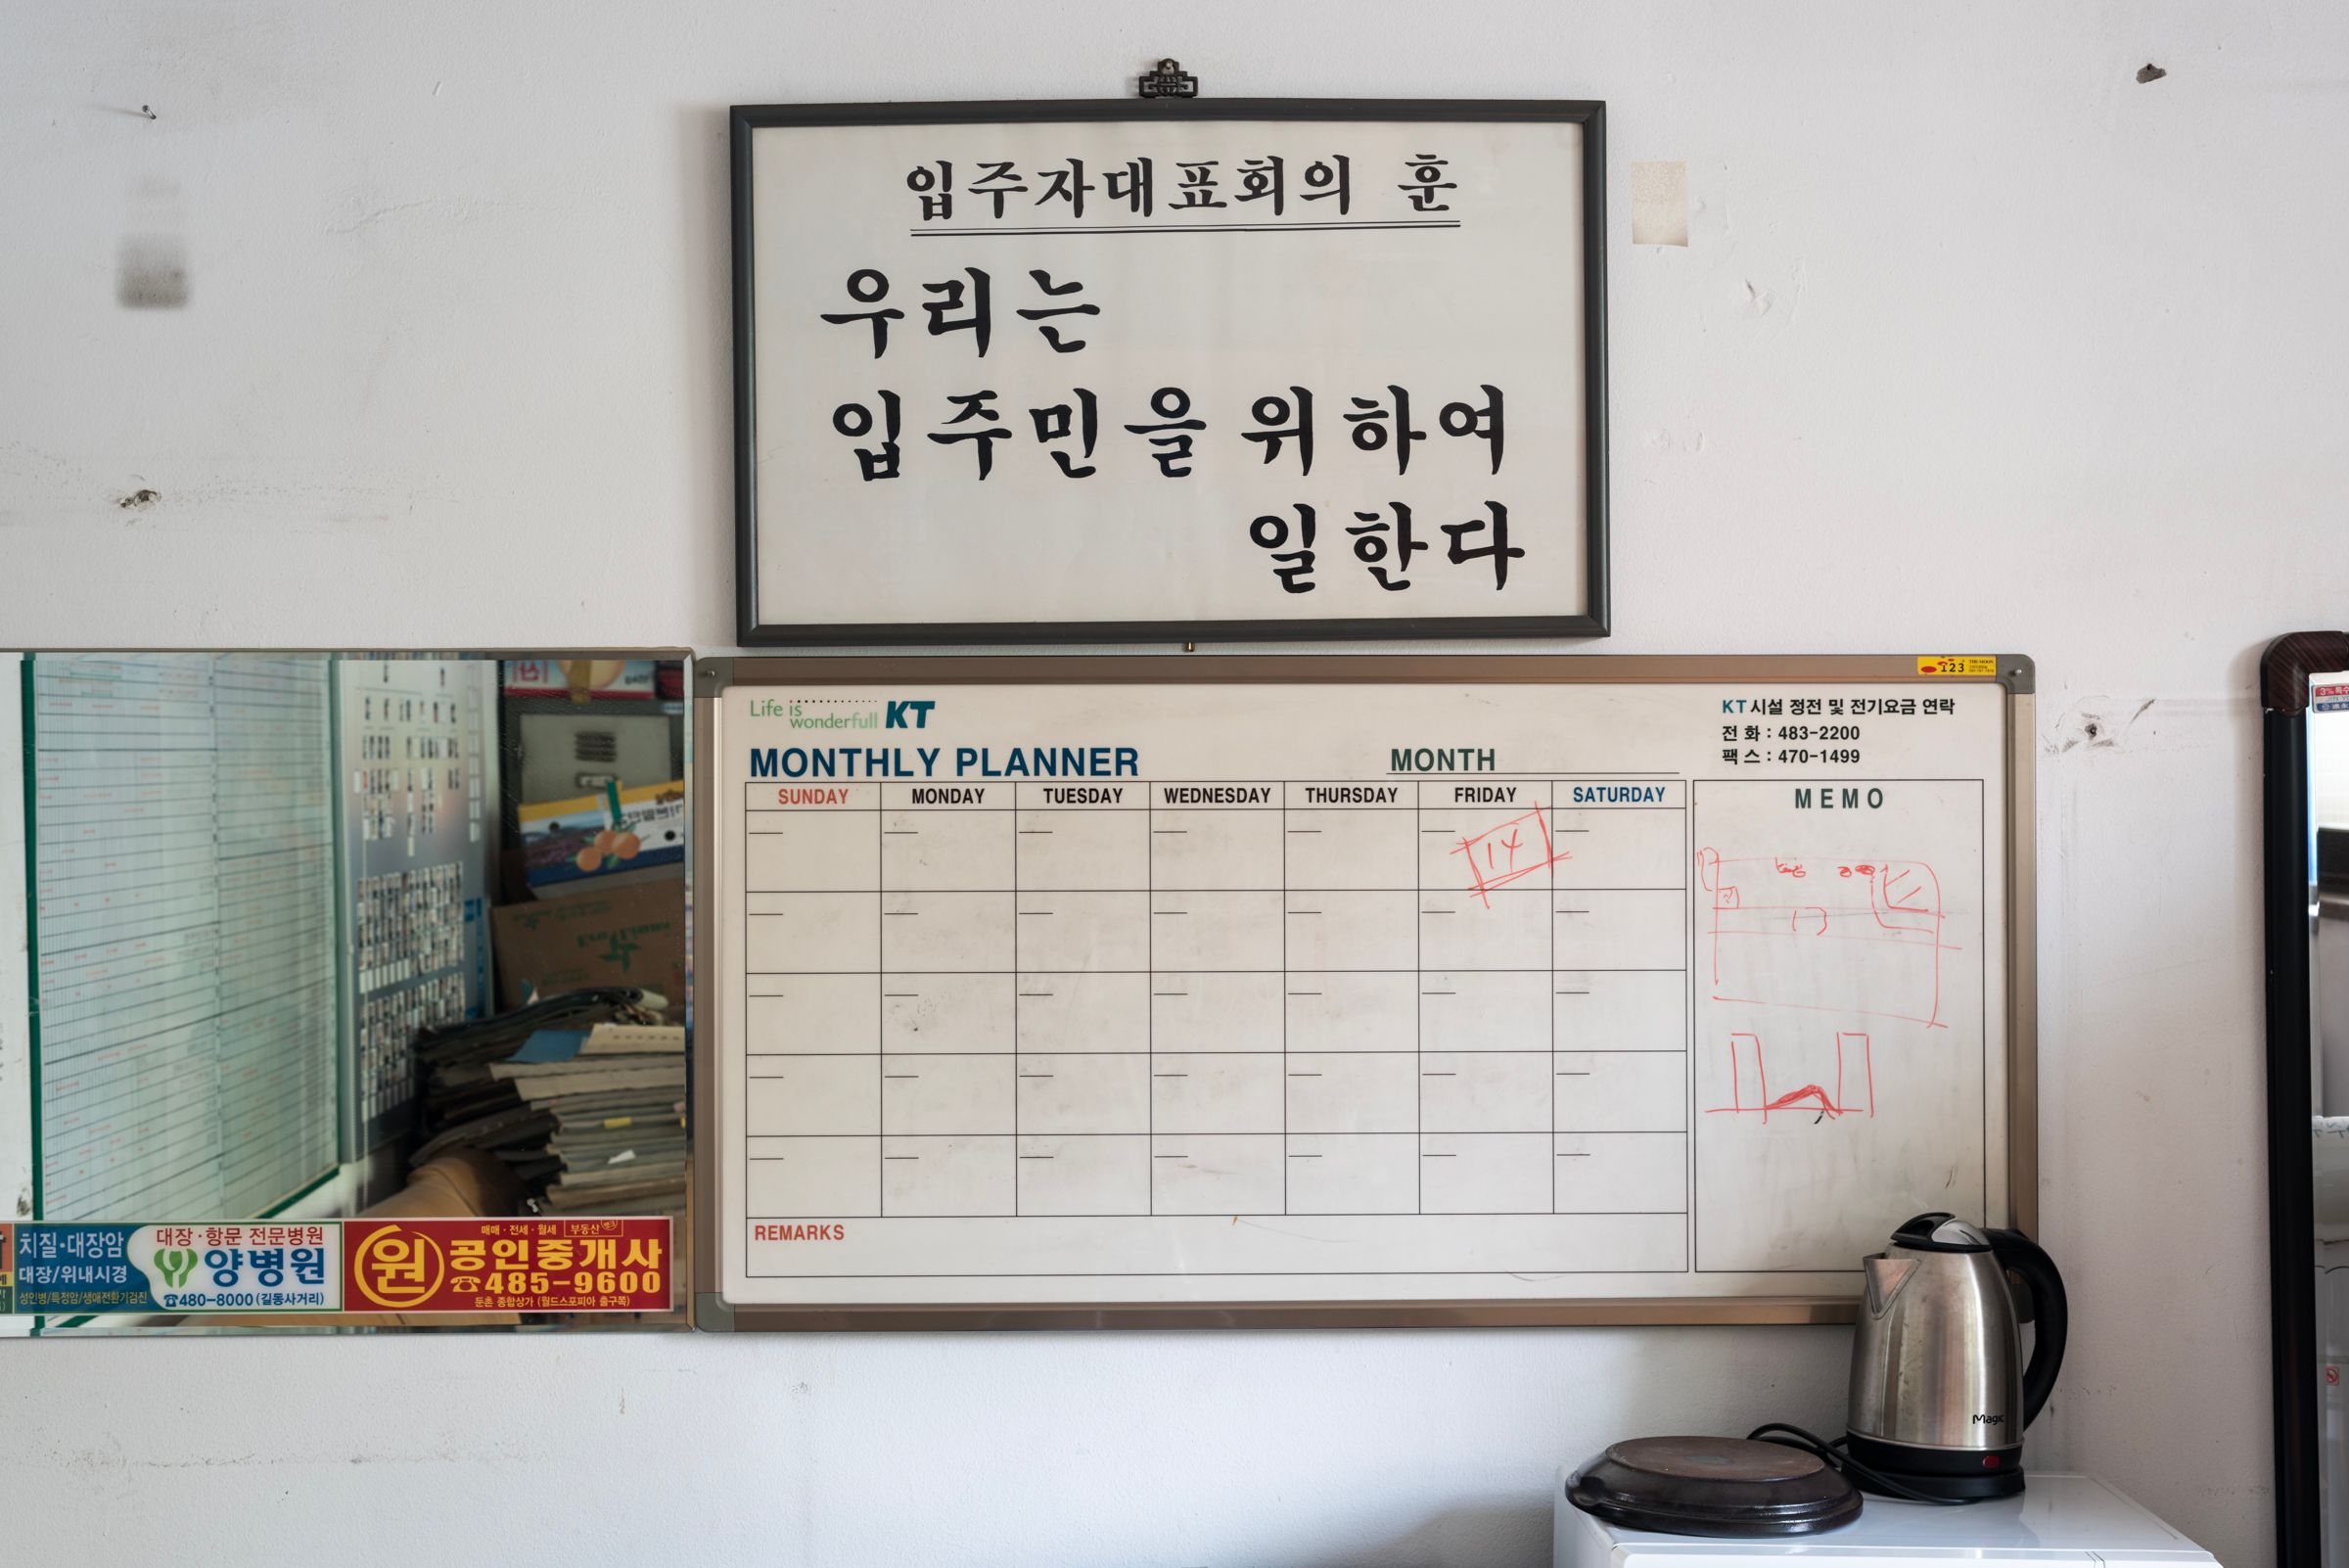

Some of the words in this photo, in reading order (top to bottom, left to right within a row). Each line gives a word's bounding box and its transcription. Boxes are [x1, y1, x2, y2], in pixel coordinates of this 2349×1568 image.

[905, 154, 1353, 221] 입주자대표회의
[1398, 154, 1460, 213] 훈
[820, 266, 1101, 359] 우리는
[831, 387, 1208, 483] 입주민을
[1241, 383, 1508, 477] 위하여
[1249, 500, 1526, 594] 일한다
[750, 699, 783, 716] Life
[789, 699, 803, 716] is
[886, 701, 936, 729] KT
[1789, 698, 1822, 715] 정전
[1828, 698, 1844, 715] 및
[1850, 697, 1917, 715] 전기요금
[1922, 697, 1956, 715] 연락
[790, 713, 878, 729] wonderfull
[1777, 725, 1860, 741] 483-2200
[750, 748, 941, 778] MONTHLY
[956, 747, 1139, 777] PLANNER
[1390, 748, 1496, 772] MONTH
[1777, 749, 1860, 764] 470-1499
[778, 788, 849, 805] SUNDAY
[911, 788, 986, 805] MONDAY
[1043, 788, 1123, 805] TUESDAY
[1164, 787, 1271, 805] WEDNESDAY
[1305, 787, 1399, 805] THURSDAY
[1454, 786, 1517, 804] FRIDAY
[1572, 786, 1666, 804] SATURDAY
[1794, 788, 1884, 809] MEMO
[250, 1226, 324, 1246] 전문병원
[571, 1223, 600, 1235] 부동산
[755, 1224, 845, 1241] REMARKS
[449, 1238, 663, 1271] 공인중개사
[19, 1265, 127, 1284] 대장/위내시경
[204, 1248, 325, 1287] 양병원
[372, 1238, 425, 1294] 원
[484, 1271, 661, 1295] 485-9600
[179, 1293, 253, 1308] 480-8000
[255, 1292, 324, 1307] (길동사거리)
[496, 1296, 533, 1308] 종합상가
[1972, 1413, 2004, 1425] Magic
